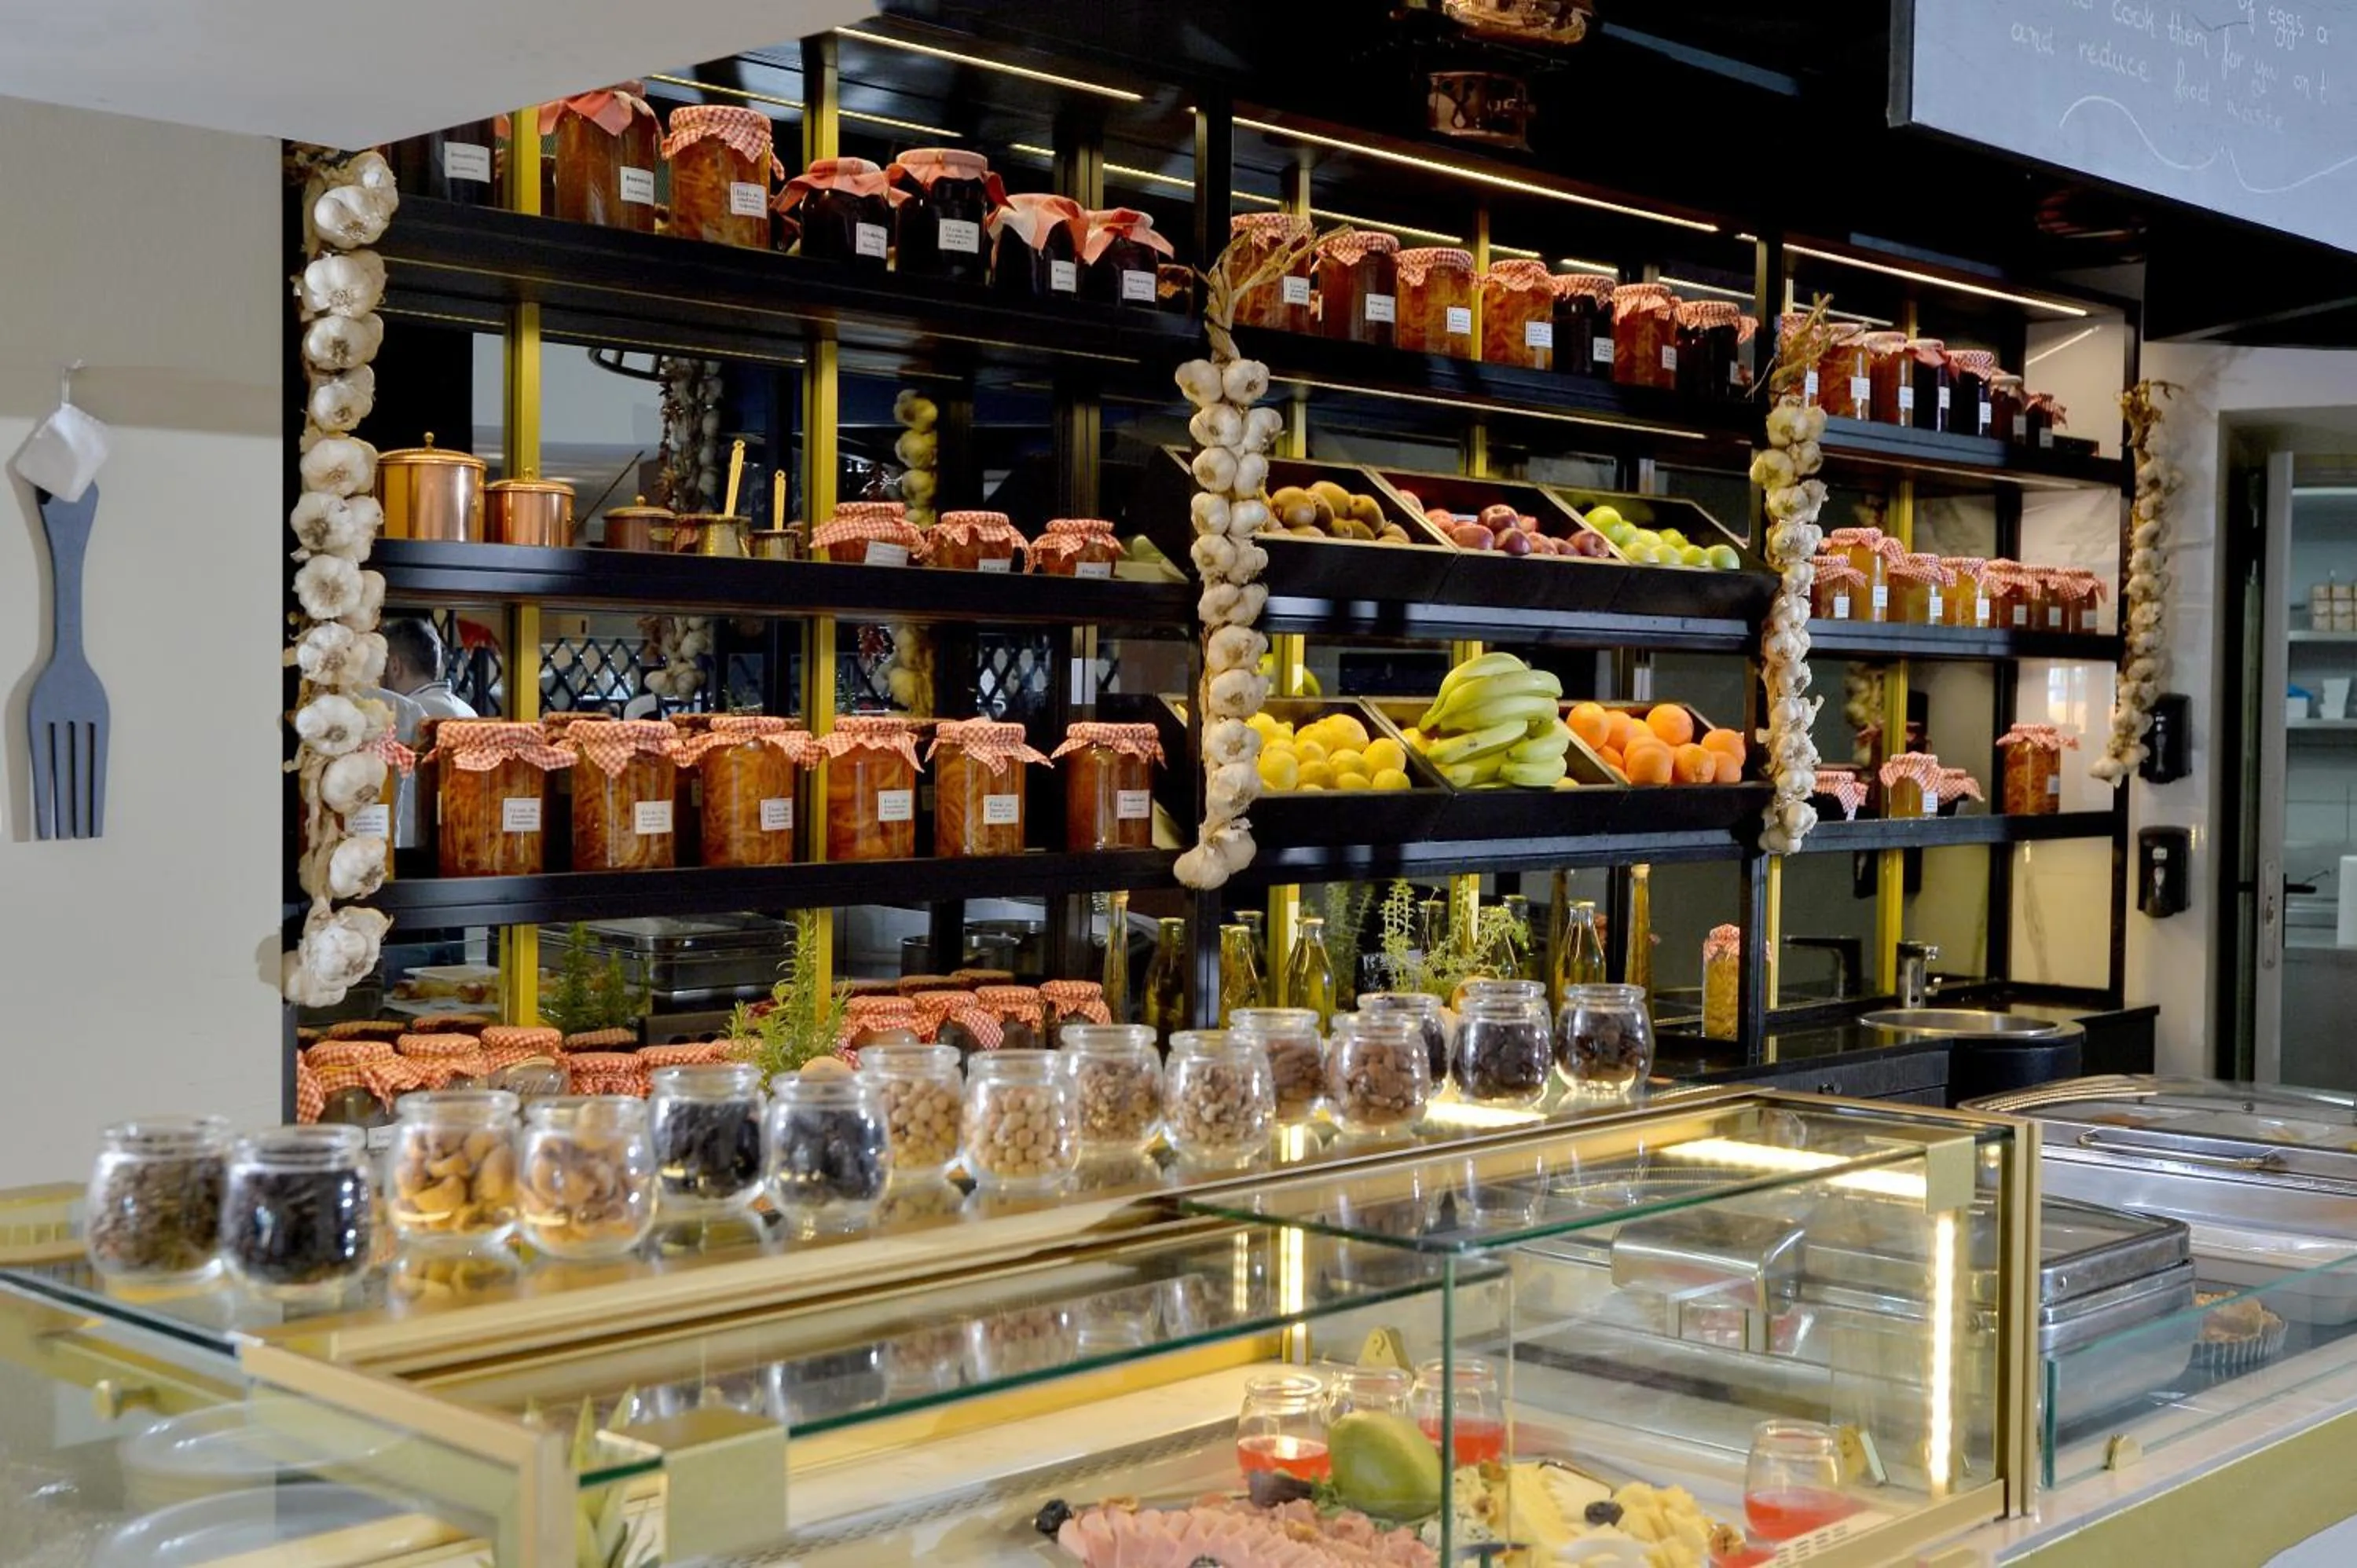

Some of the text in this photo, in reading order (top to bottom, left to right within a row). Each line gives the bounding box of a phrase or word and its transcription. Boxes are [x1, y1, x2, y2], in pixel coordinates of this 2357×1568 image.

[2167, 11, 2210, 60] them
[2221, 25, 2244, 81] for
[2267, 6, 2305, 50] eggs
[2011, 22, 2055, 57] and
[2077, 38, 2152, 82] reduce
[2174, 57, 2212, 107] food
